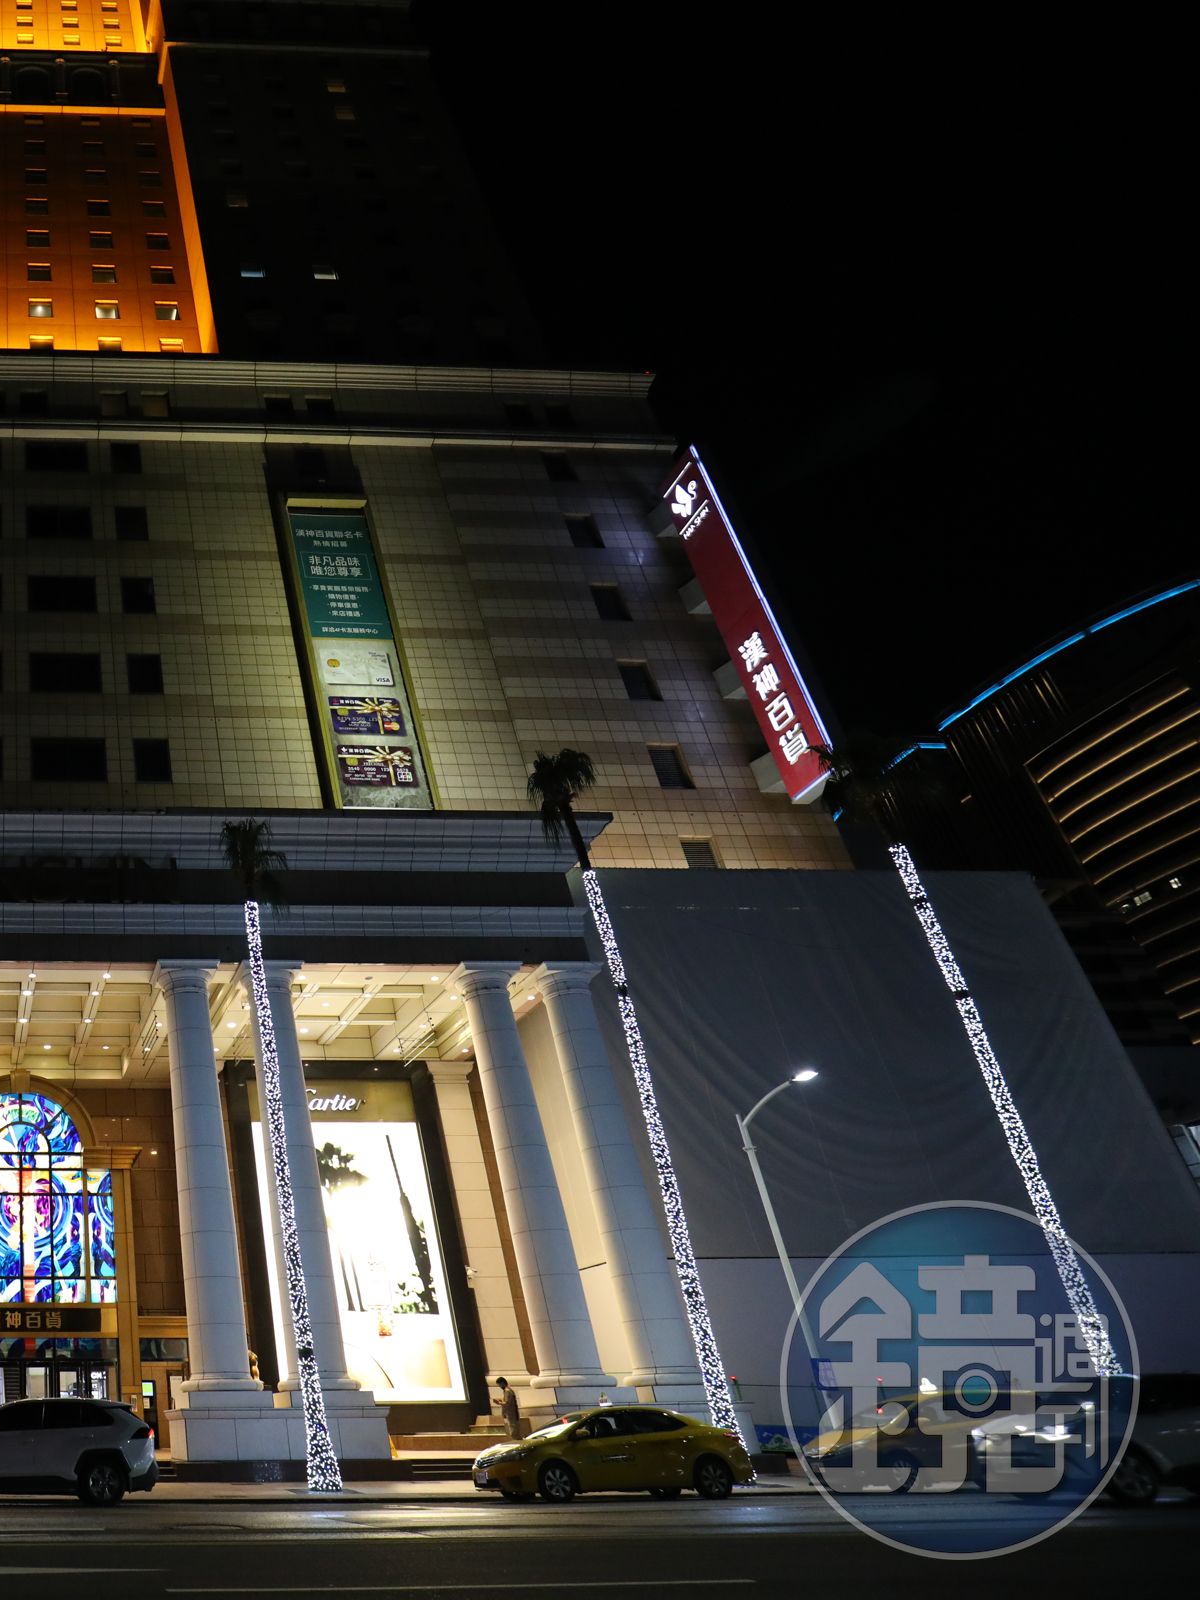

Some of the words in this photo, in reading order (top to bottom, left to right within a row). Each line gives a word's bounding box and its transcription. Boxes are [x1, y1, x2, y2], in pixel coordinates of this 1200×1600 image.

[308, 555, 360, 567] 非凡品味
[310, 566, 363, 577] 唯您尊享
[738, 631, 811, 766] 漢神百貨
